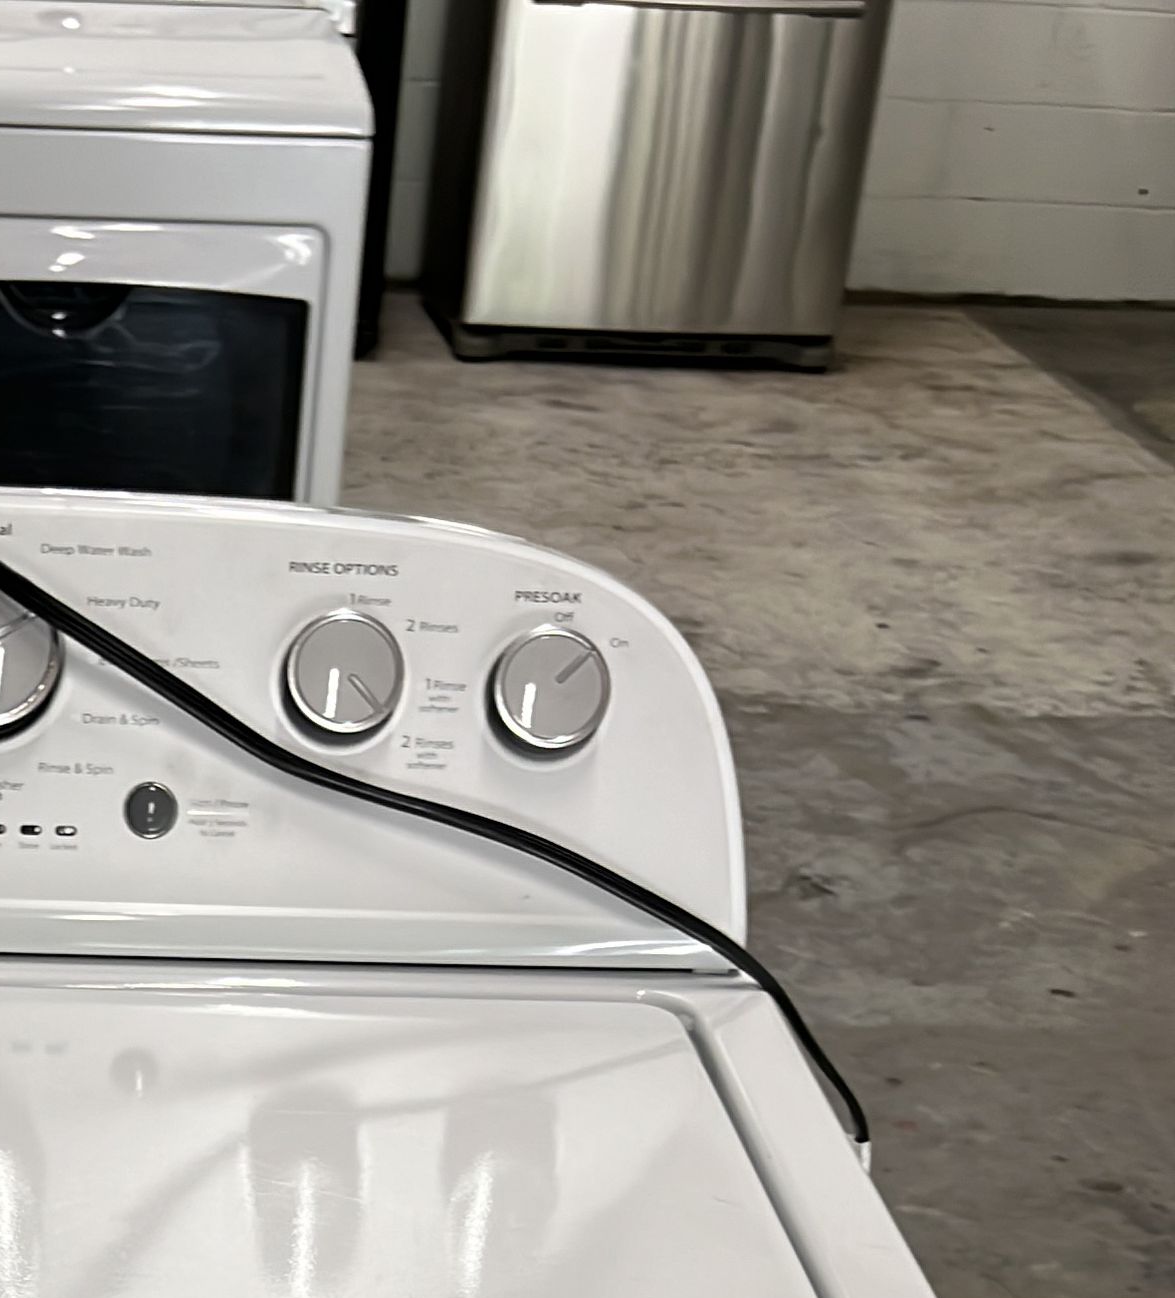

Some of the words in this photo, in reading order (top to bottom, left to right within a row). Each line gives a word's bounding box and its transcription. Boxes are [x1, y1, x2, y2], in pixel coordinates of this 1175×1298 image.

[40, 543, 76, 556] Deep
[77, 545, 115, 556] Water
[117, 546, 153, 557] Wash
[288, 561, 331, 575] RINSE
[332, 563, 399, 577] OPTIONS
[86, 596, 126, 609] Heavy
[128, 596, 161, 611] Duty
[514, 590, 583, 604] PRESOAK
[554, 611, 575, 623] Off
[405, 619, 416, 632] 2
[419, 621, 459, 633] Rinses
[609, 637, 630, 648] On
[80, 713, 117, 725] Drain
[119, 713, 129, 725] &
[130, 714, 161, 727] Spin
[400, 735, 411, 748] 2
[415, 737, 455, 749] Rinses
[37, 762, 72, 775] Rinse
[73, 762, 83, 775] &
[85, 763, 115, 777] Spin
